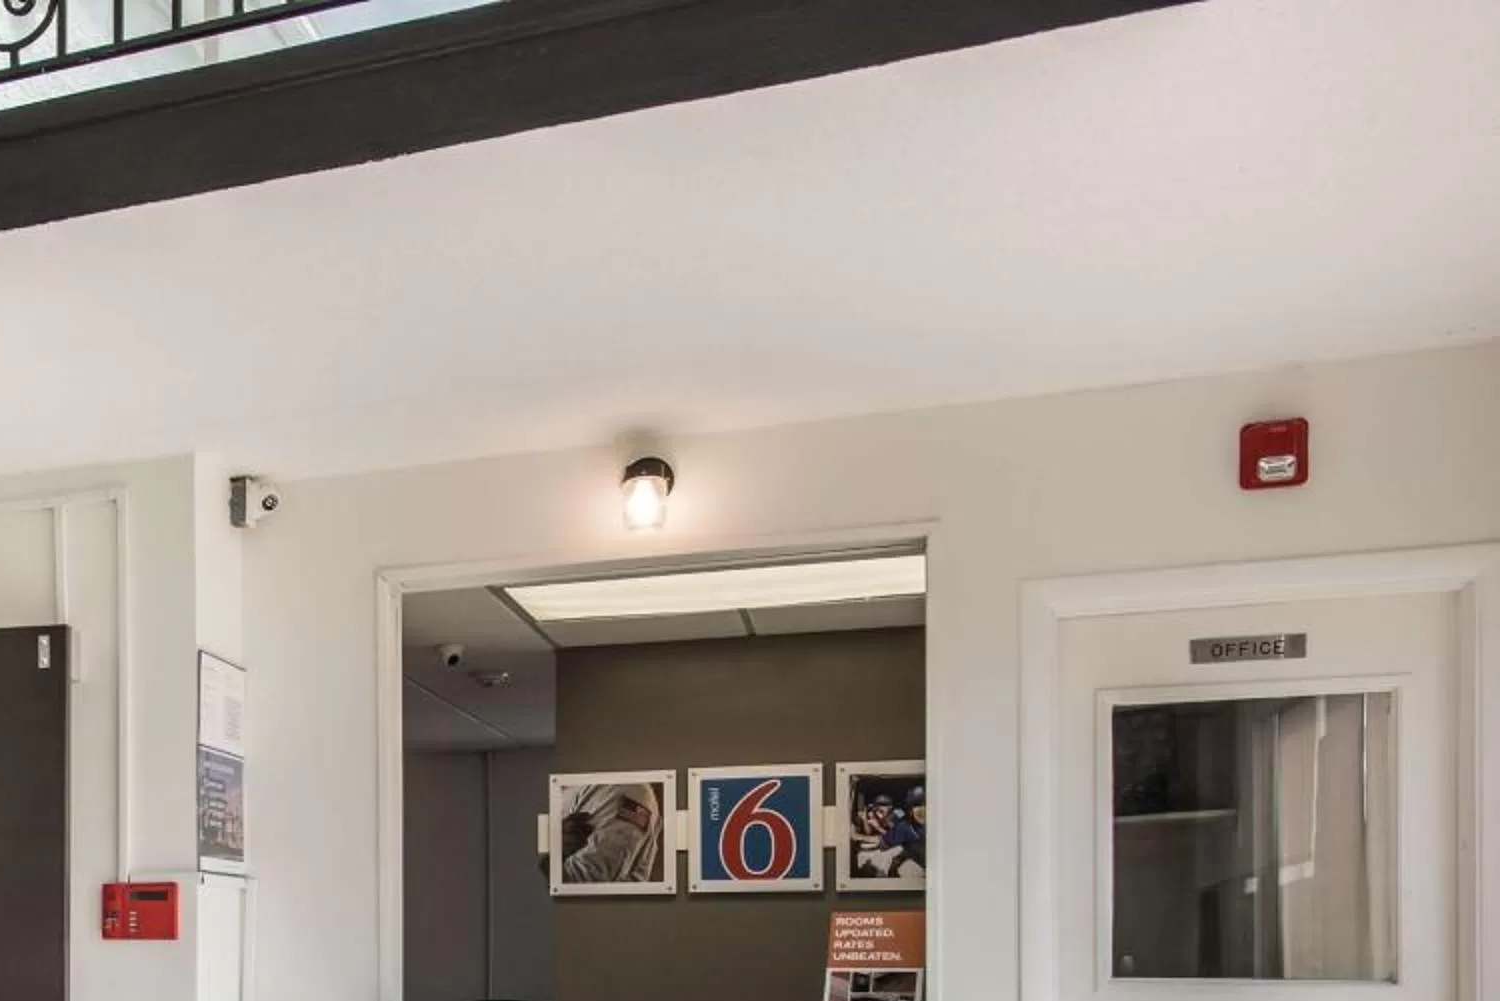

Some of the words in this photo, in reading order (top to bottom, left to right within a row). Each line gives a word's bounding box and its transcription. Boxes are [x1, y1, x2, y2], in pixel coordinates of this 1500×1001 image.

[1211, 639, 1284, 657] OFFICE
[707, 786, 720, 822] motel
[719, 779, 796, 881] 6
[835, 917, 884, 926] ROOMS
[833, 940, 876, 949] RATES
